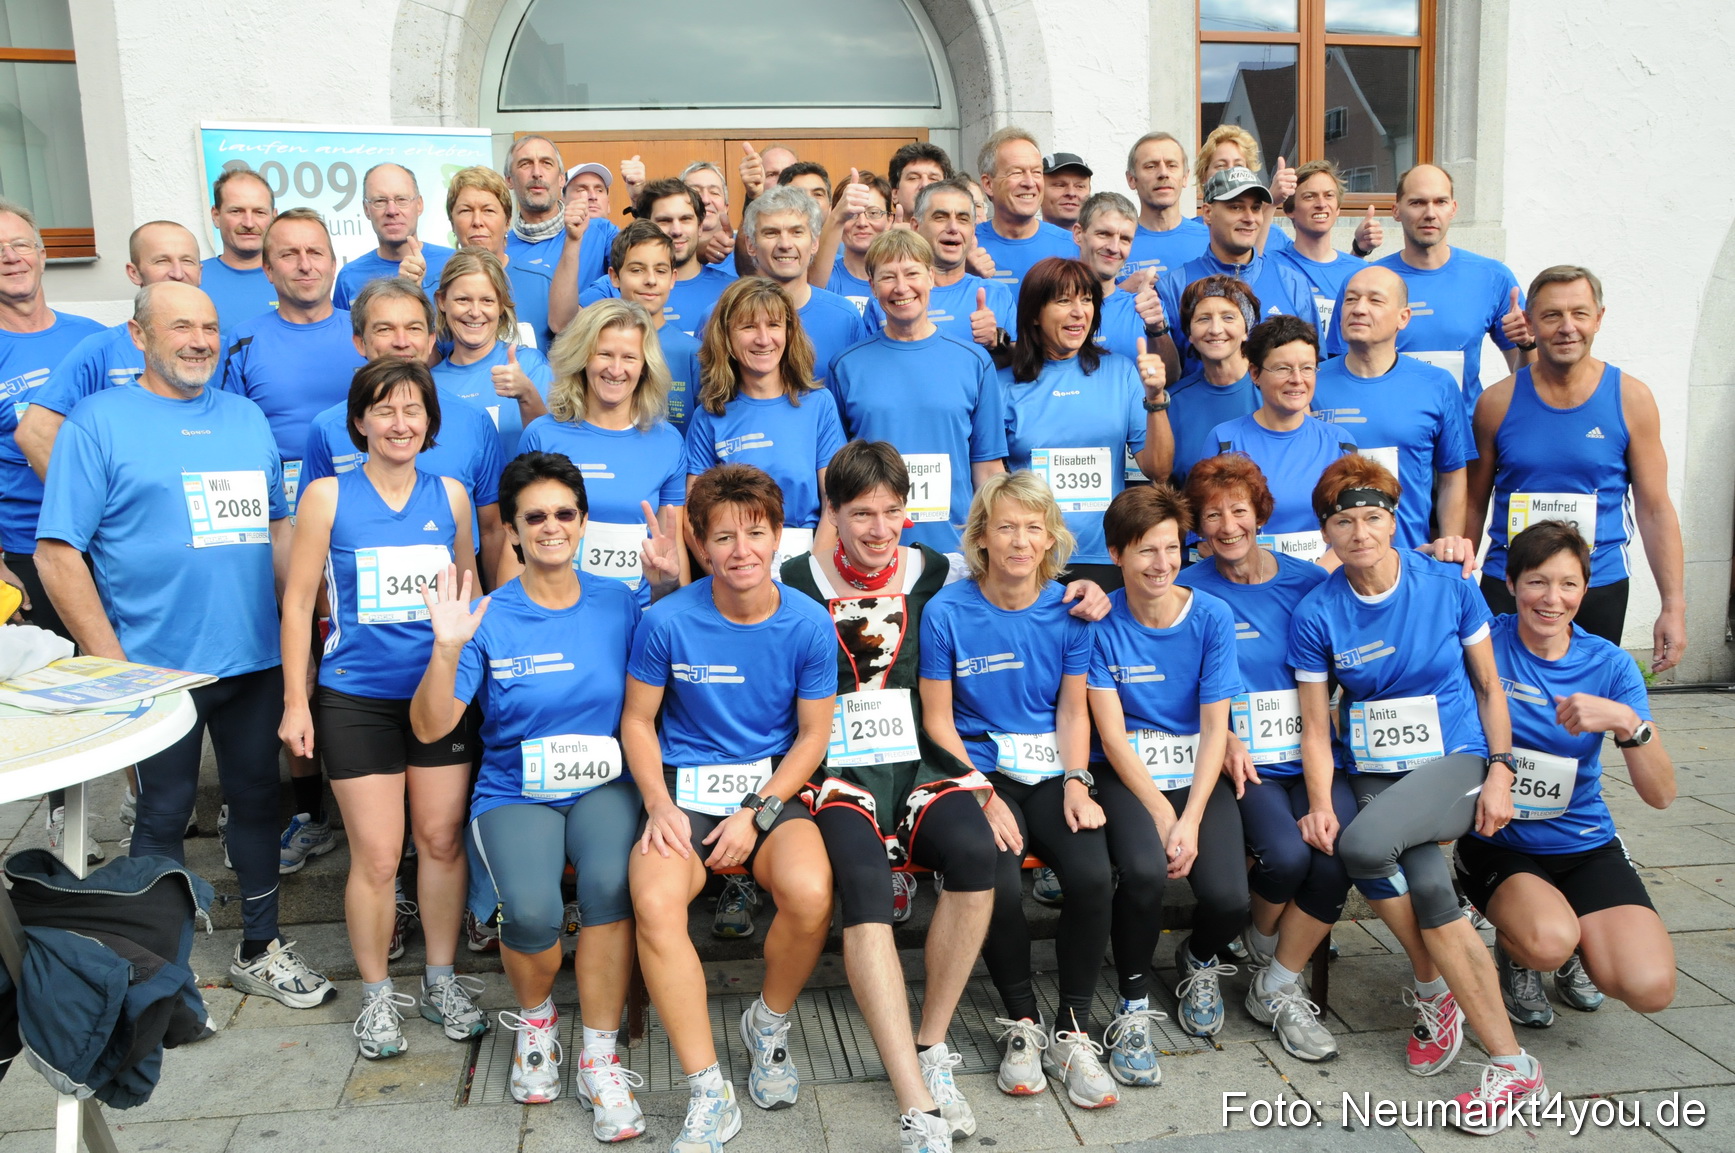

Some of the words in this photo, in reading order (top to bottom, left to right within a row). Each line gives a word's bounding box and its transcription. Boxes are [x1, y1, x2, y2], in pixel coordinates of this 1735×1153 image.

[219, 139, 308, 155] laufen
[315, 144, 396, 156] anders
[403, 144, 485, 157] erleben
[222, 159, 357, 212] 009
[321, 213, 362, 236] uni
[1054, 454, 1096, 466] Elisabeth
[906, 461, 941, 476] degard
[208, 479, 231, 491] Willi
[1056, 473, 1102, 489] 3399
[289, 485, 295, 494] A
[215, 499, 262, 518] 2088
[1532, 499, 1577, 512] Manfred
[1512, 517, 1518, 526] B
[589, 548, 638, 568] 3733
[386, 574, 438, 595] 3494
[847, 699, 882, 713] Reiner
[1256, 698, 1280, 711] Gabi
[1369, 708, 1397, 721] Anita
[851, 717, 904, 740] 2308
[1240, 720, 1245, 730] A
[1260, 715, 1303, 738] 2168
[1355, 728, 1361, 738] C
[1373, 723, 1430, 747] 2953
[550, 741, 588, 754] Karola
[1023, 742, 1059, 763] 259
[1145, 745, 1194, 766] 2151
[1516, 756, 1535, 770] ika
[530, 762, 537, 773] D
[553, 760, 611, 781] 3440
[685, 774, 691, 784] A
[707, 774, 763, 794] 2587
[1510, 775, 1562, 800] 2564
